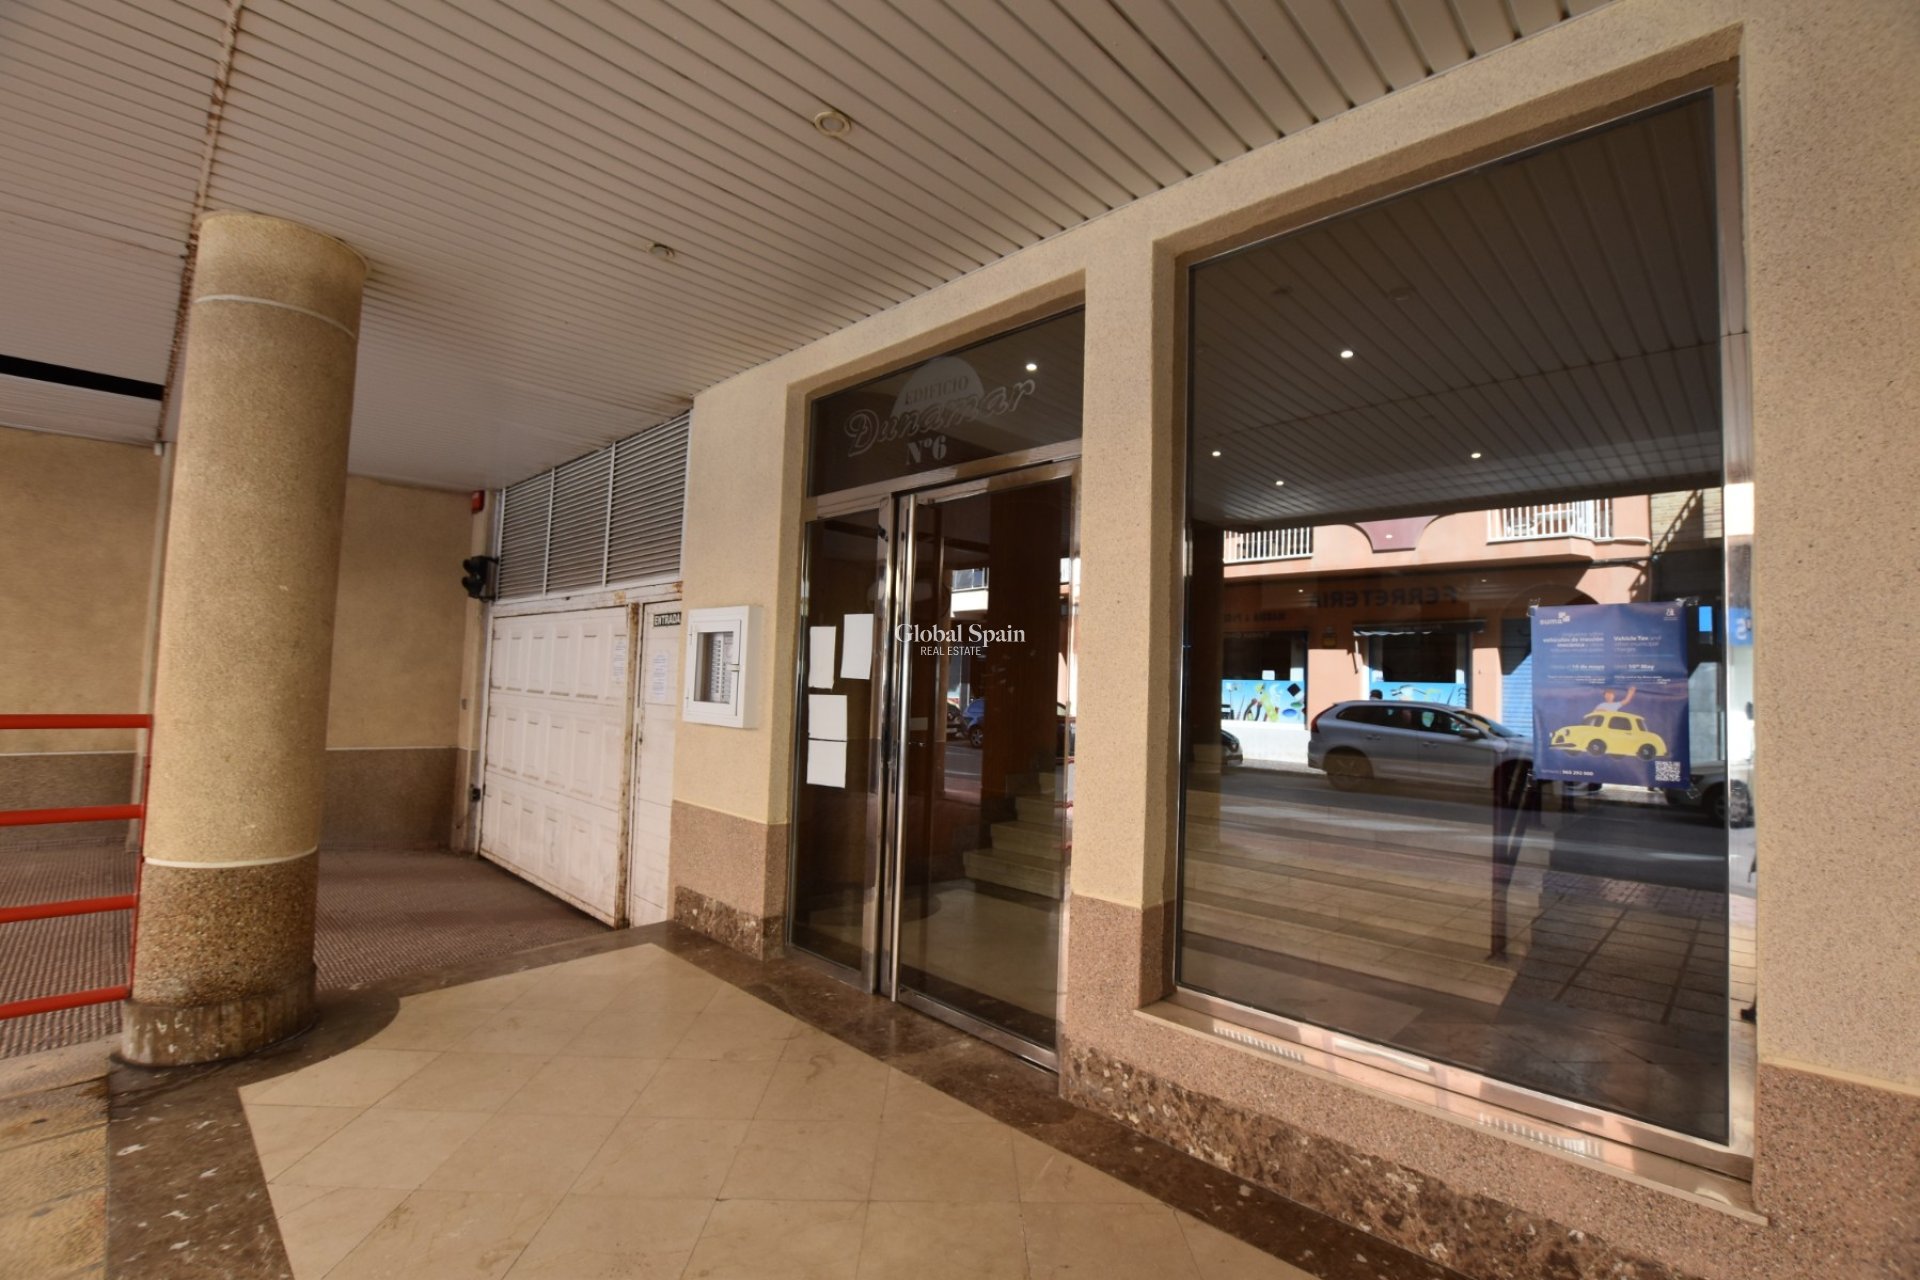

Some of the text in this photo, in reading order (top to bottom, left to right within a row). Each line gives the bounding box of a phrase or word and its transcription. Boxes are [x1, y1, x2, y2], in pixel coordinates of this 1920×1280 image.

[905, 375, 969, 405] EDIFICIO
[844, 379, 1036, 458] Dunamar
[654, 613, 681, 626] ENTRADA
